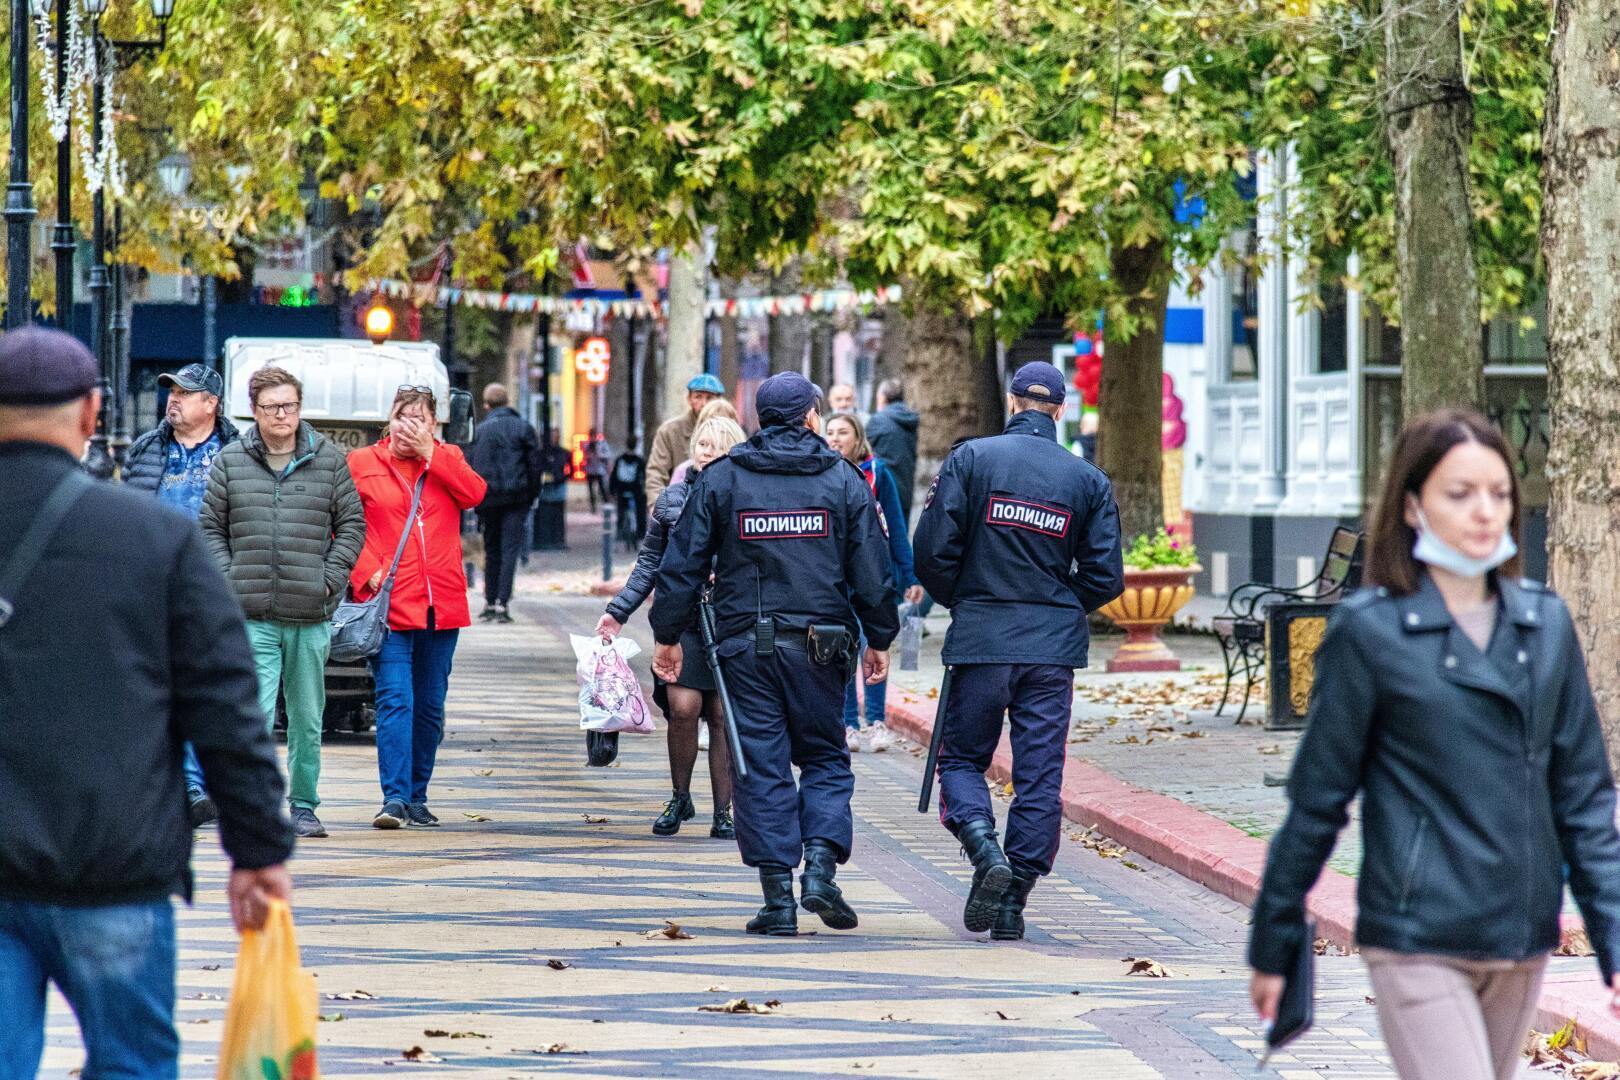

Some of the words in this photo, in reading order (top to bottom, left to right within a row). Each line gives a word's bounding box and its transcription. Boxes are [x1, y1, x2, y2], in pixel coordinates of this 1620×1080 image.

[316, 429, 360, 448] 340
[744, 515, 823, 534] ПОЛИЦИЯ
[992, 503, 1066, 532] ПОЛИЦИЯ
